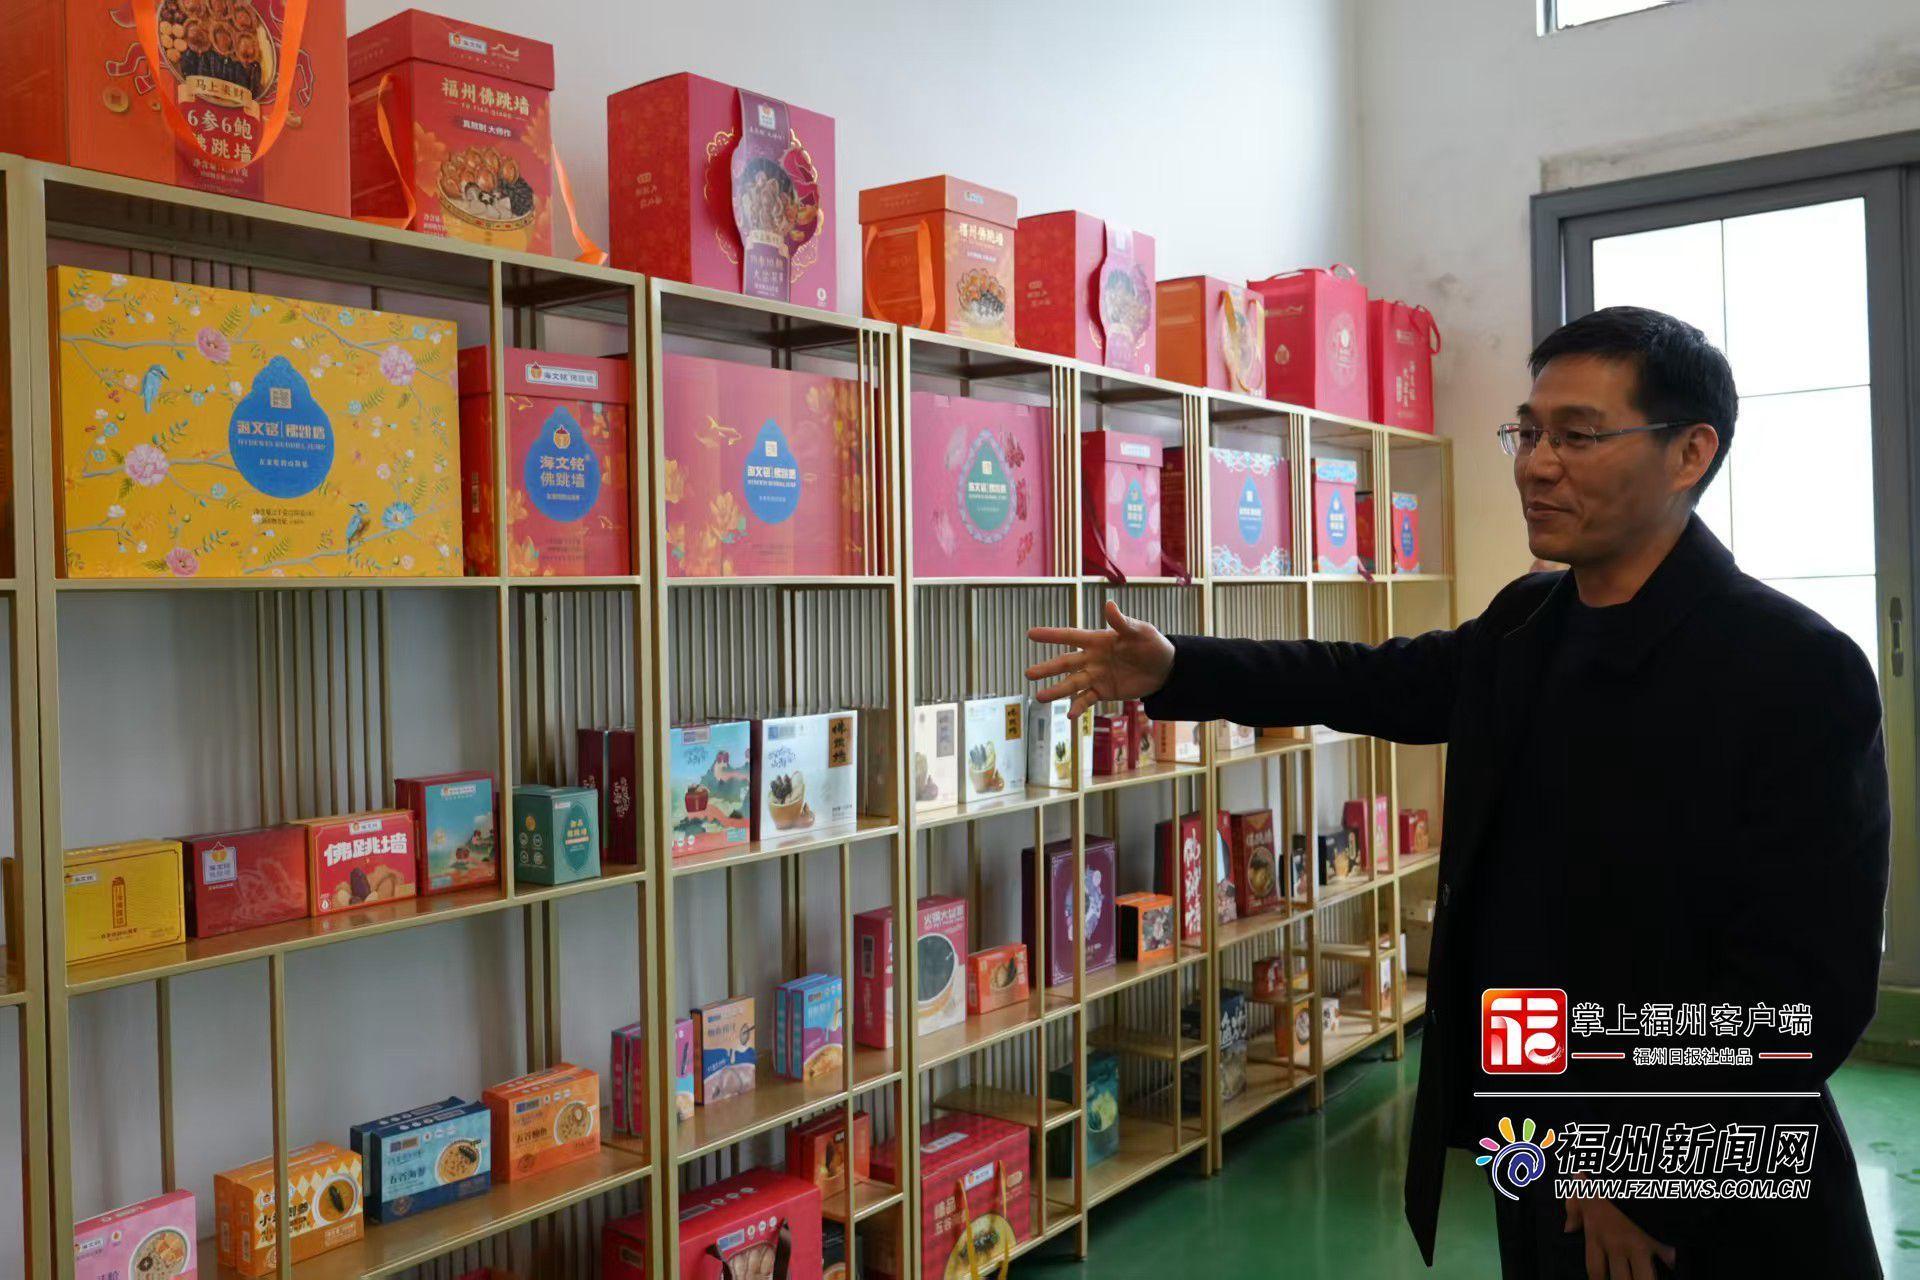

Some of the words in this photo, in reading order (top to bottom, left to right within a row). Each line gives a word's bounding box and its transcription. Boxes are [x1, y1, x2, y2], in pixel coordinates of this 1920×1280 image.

[441, 77, 530, 116] 福州佛跳墙
[187, 109, 253, 140] 6参6鲍
[540, 455, 586, 471] 海文铭
[540, 471, 586, 488] 佛跳墙
[323, 832, 408, 868] 佛跳墙
